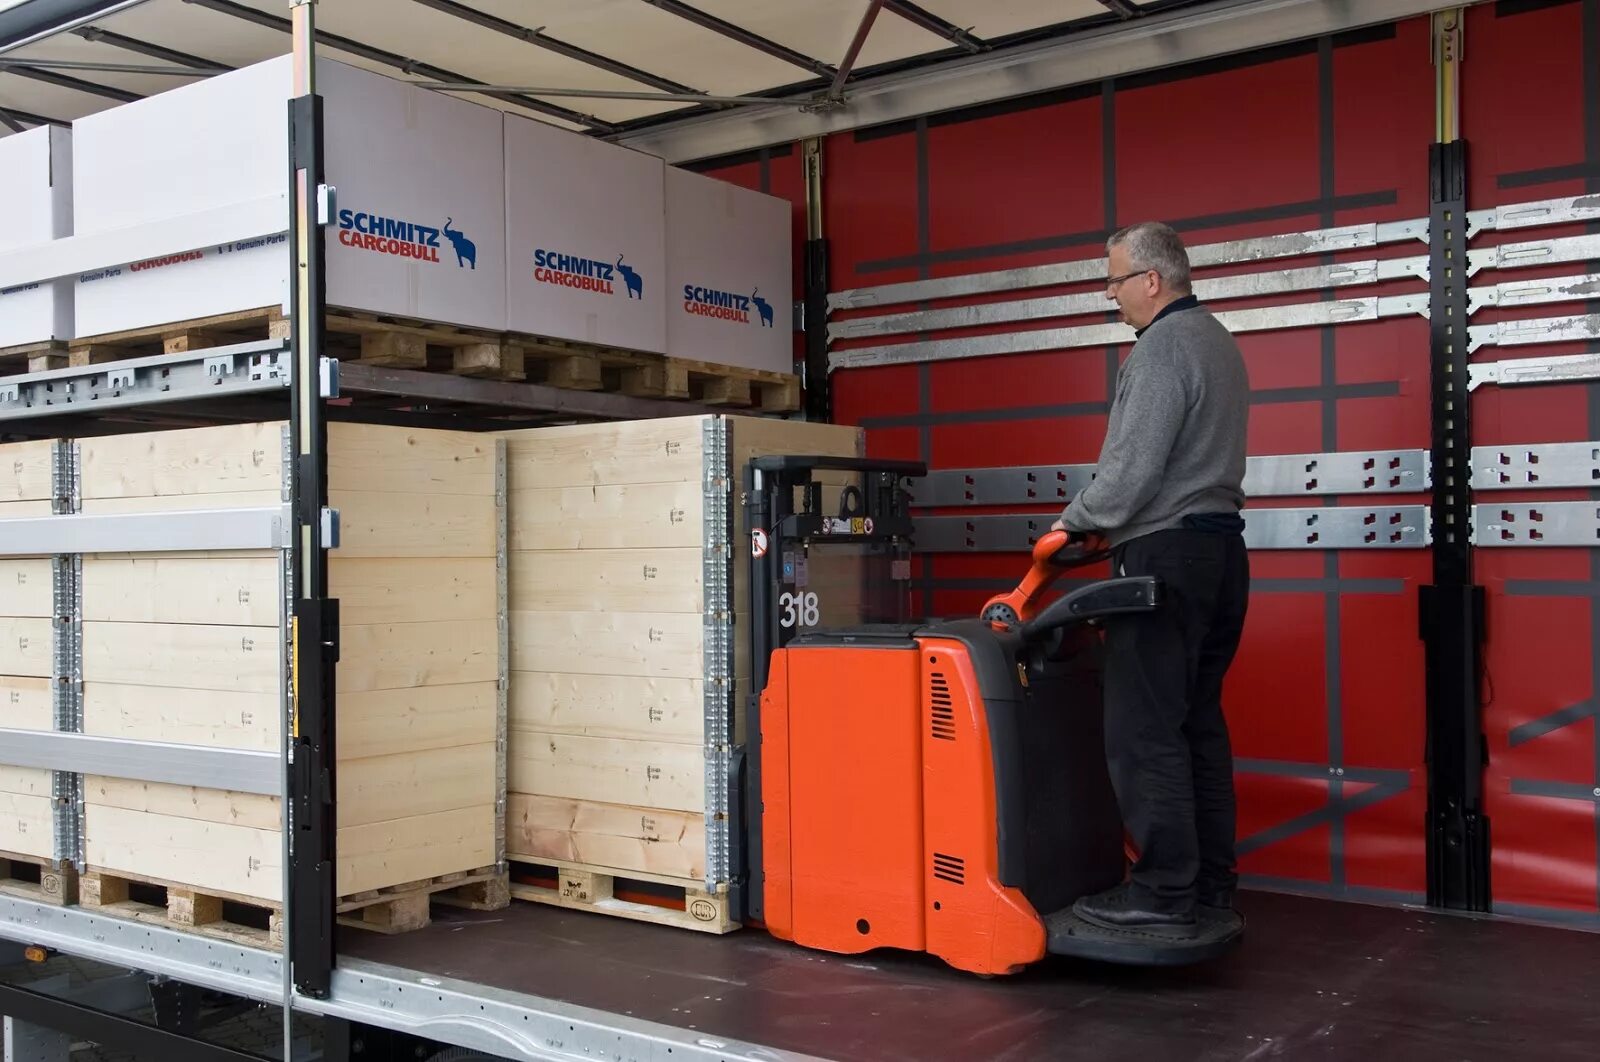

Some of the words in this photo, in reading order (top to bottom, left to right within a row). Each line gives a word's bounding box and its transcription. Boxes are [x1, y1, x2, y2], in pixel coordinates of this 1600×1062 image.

[236, 239, 265, 251] Genuine
[266, 234, 286, 245] Parts
[339, 209, 440, 248] SCHMITZ
[339, 230, 439, 263] CARGOBULL
[534, 249, 614, 280] SCHMITZ
[534, 267, 614, 295] CARGOBULL
[684, 284, 750, 311] SCHMITZ
[684, 301, 750, 324] CARGOBULL
[779, 591, 819, 628] 318
[695, 903, 712, 918] EUR
